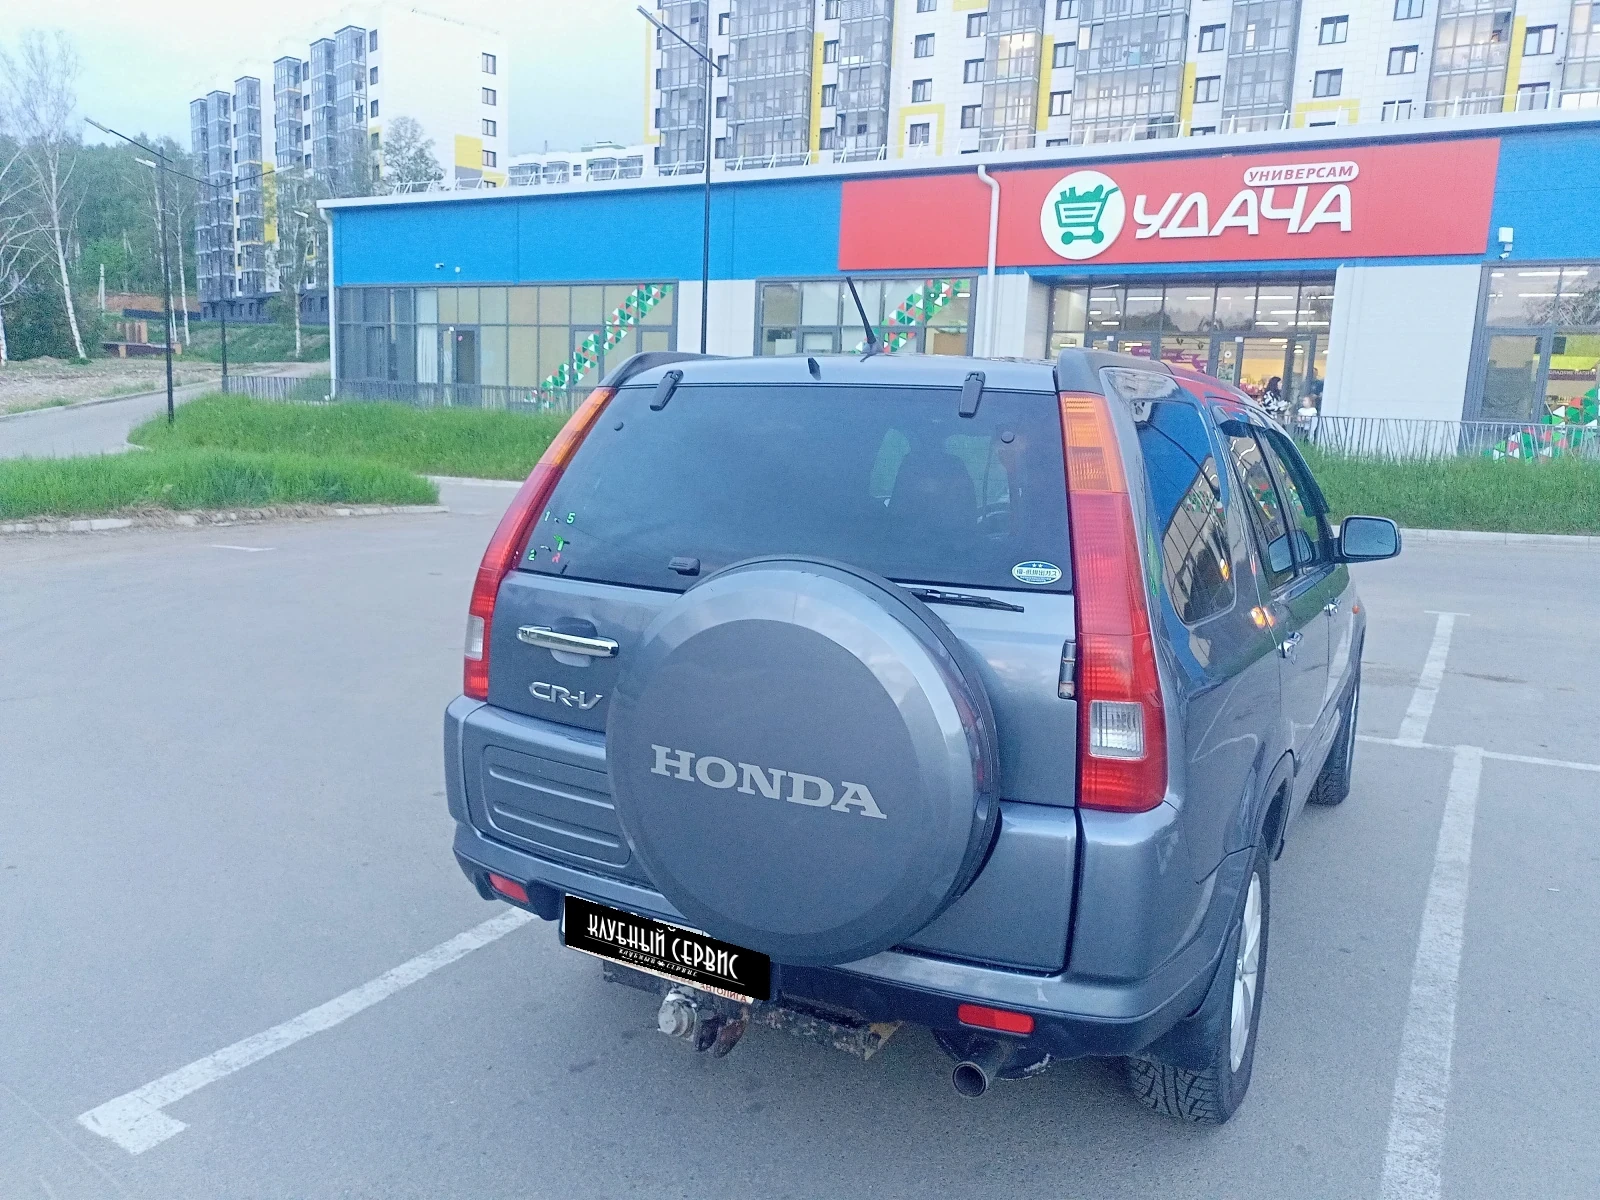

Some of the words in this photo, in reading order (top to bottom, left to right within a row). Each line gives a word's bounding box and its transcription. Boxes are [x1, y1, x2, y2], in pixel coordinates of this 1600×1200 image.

[1248, 165, 1354, 182] УНИВЕРСАМ
[1132, 184, 1352, 239] УДАЧА
[566, 512, 576, 524] 5
[529, 681, 603, 711] CR-V
[650, 743, 888, 820] HONDA
